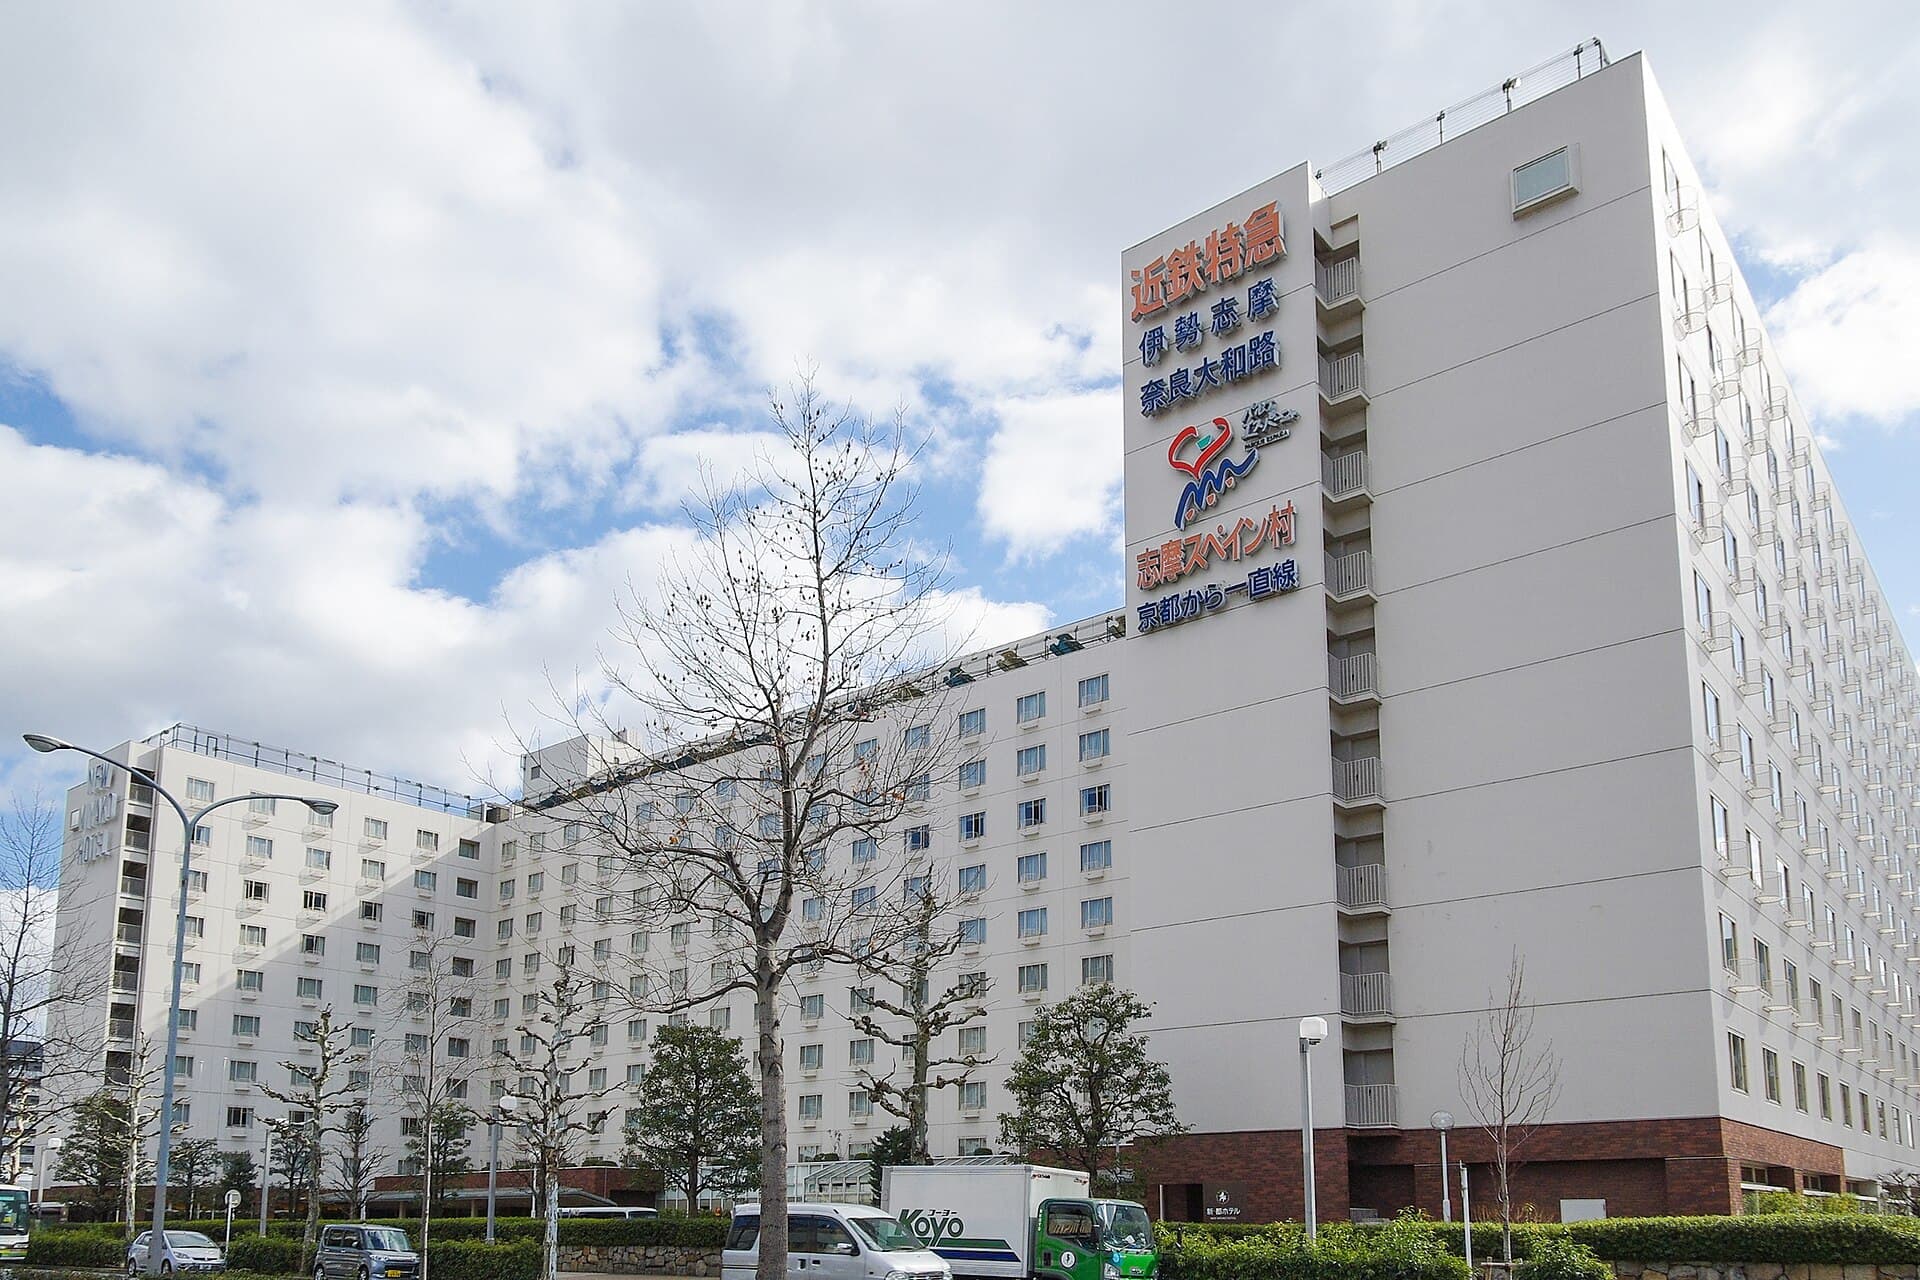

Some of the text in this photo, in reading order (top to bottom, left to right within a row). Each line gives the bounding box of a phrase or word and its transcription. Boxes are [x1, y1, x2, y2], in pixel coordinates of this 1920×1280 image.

[1131, 200, 1286, 322] 近鉄特急
[1139, 277, 1279, 367] 伊勢志摩
[1140, 330, 1280, 416] 奈良大和路
[1136, 500, 1298, 590] 志摩スペイン村
[1137, 559, 1299, 631] 京都から一直線
[899, 1208, 964, 1247] Koyo
[928, 1209, 958, 1217] コーヨー
